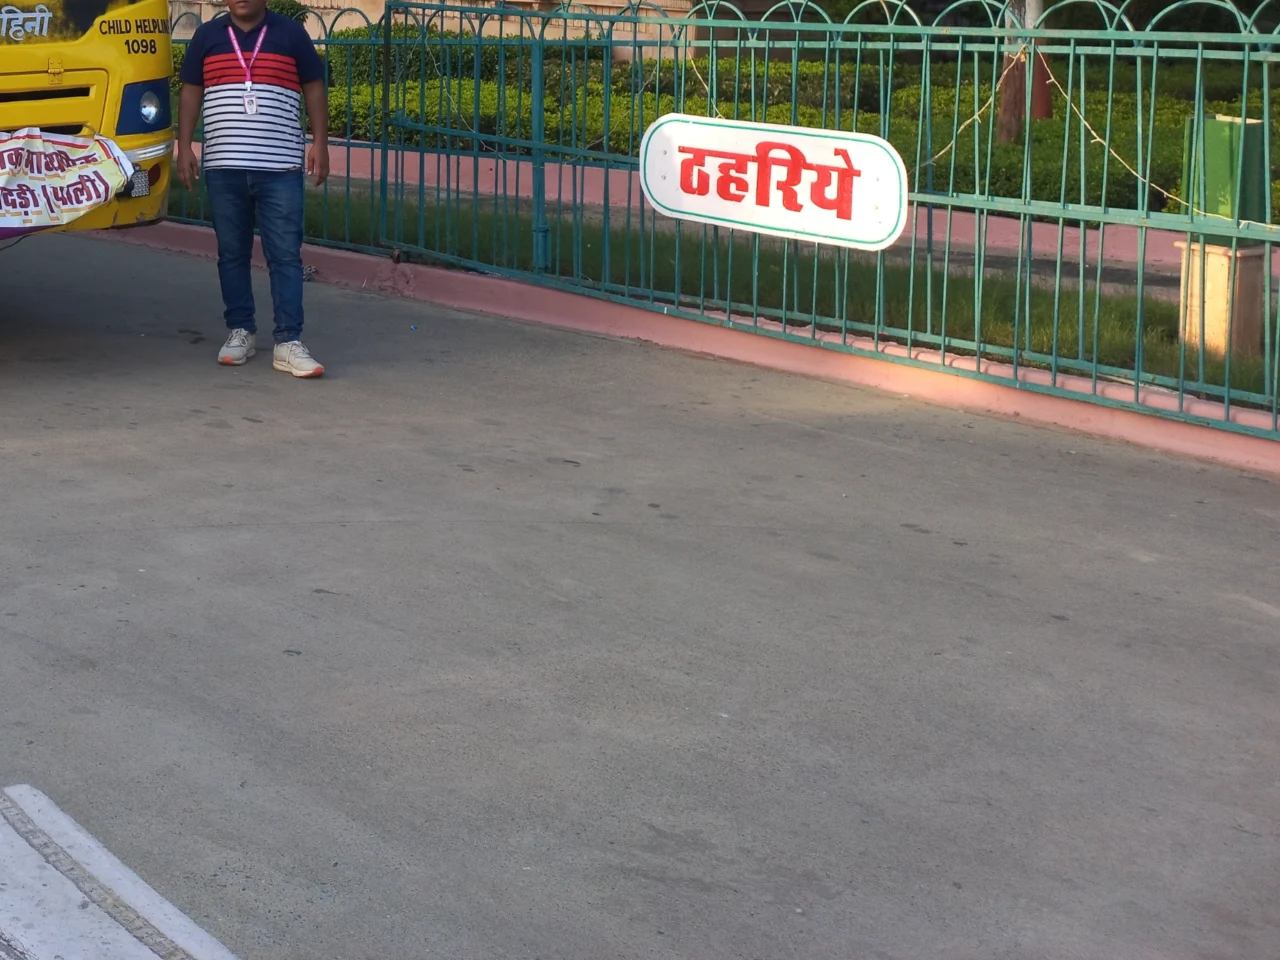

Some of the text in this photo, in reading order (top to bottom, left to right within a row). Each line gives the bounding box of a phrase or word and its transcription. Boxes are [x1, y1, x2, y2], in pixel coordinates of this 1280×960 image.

[99, 18, 170, 35] CHILD HELPLIN
[124, 38, 157, 55] 1098
[678, 141, 861, 220] ठहरिये
